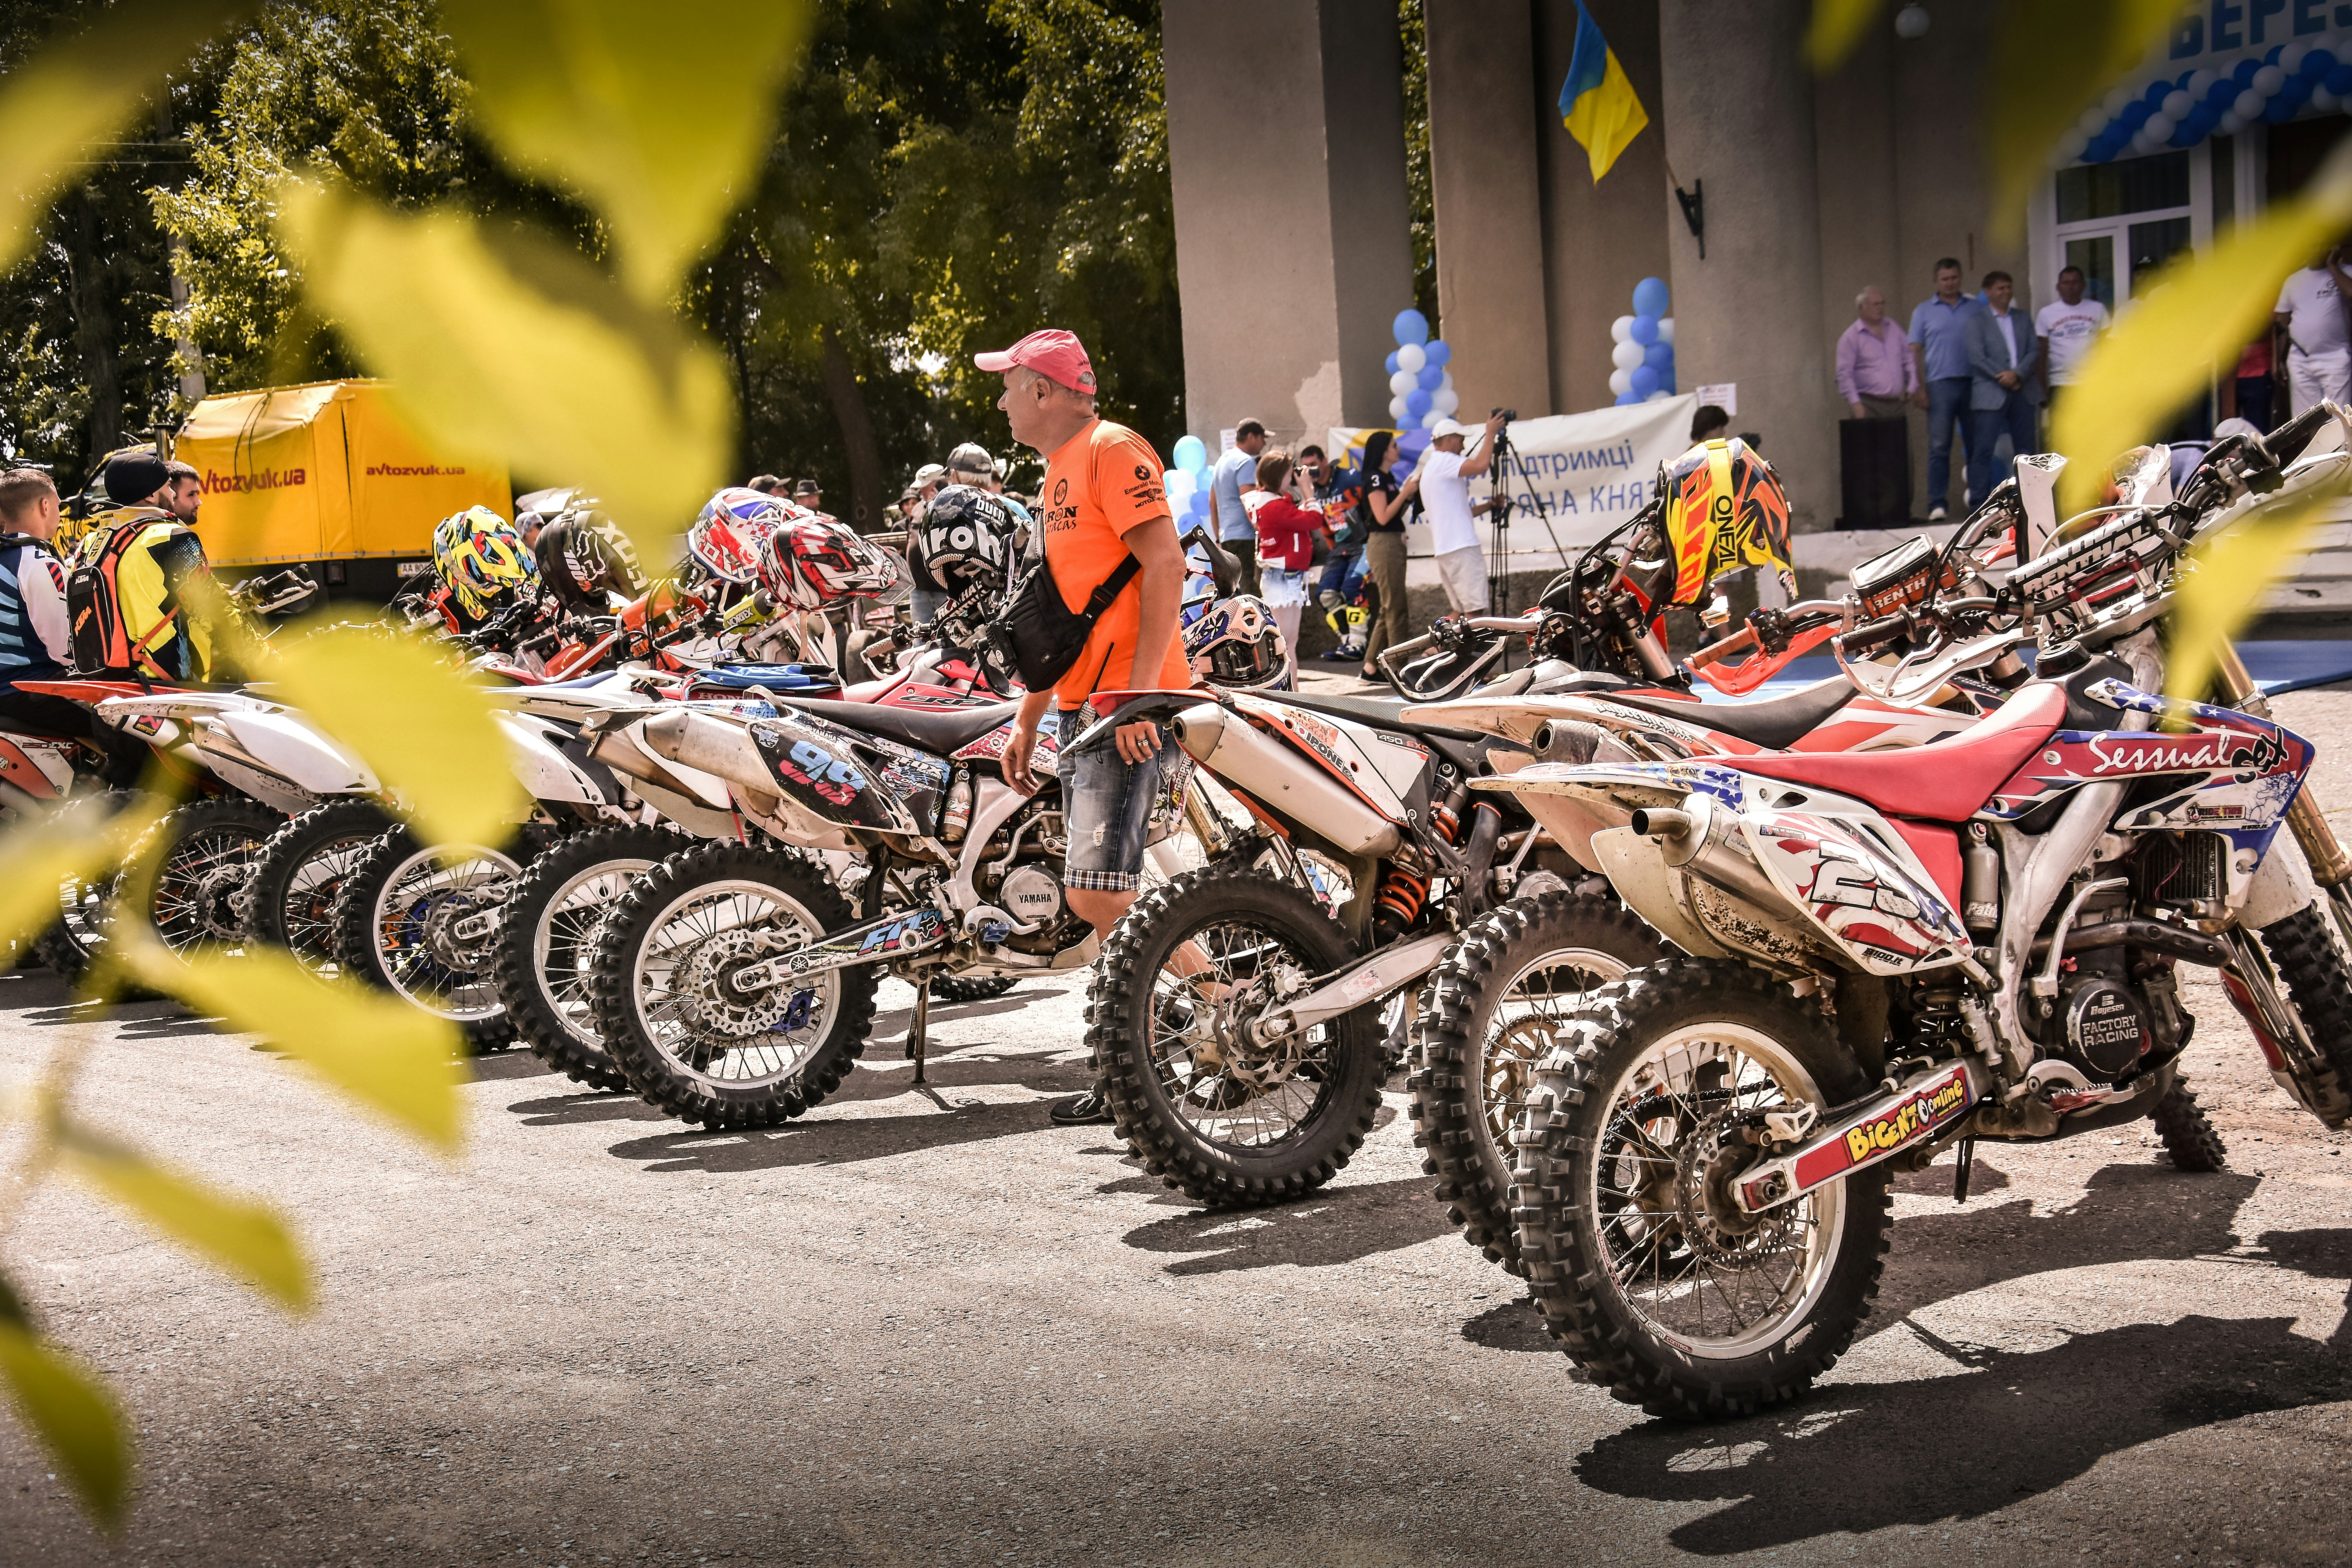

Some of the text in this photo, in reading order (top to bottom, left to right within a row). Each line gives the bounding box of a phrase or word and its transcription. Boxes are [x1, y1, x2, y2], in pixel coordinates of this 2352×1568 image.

[367, 463, 465, 475] avtozvuk.ua
[197, 468, 306, 494] vtozvuk.ua
[1124, 481, 1149, 495] Emerald
[1372, 475, 1380, 486] 3
[976, 495, 1005, 523] burn
[918, 519, 1001, 567] iroh
[2023, 525, 2151, 596] RENTHAL
[75, 575, 89, 584] KTM
[74, 606, 92, 636] KTM
[727, 606, 754, 627] VORTEX
[812, 727, 838, 742] YAMAHA
[1289, 713, 1328, 743] maracas
[1649, 723, 1694, 744] RACING
[1306, 732, 1343, 767] IPONE
[1379, 735, 1428, 752] 450 EXC
[2089, 724, 2230, 773] Sessual
[898, 756, 945, 777] FOX
[916, 768, 942, 779] RACING
[1809, 838, 1921, 921] 29
[1019, 893, 1052, 904] YAMAHA
[2091, 1004, 2125, 1016] Boyesen
[2082, 1015, 2136, 1035] FACTORY
[2084, 1027, 2139, 1047] RACING
[1597, 1229, 1612, 1269] TRACTION
[1666, 1336, 1691, 1352] CONTROL
